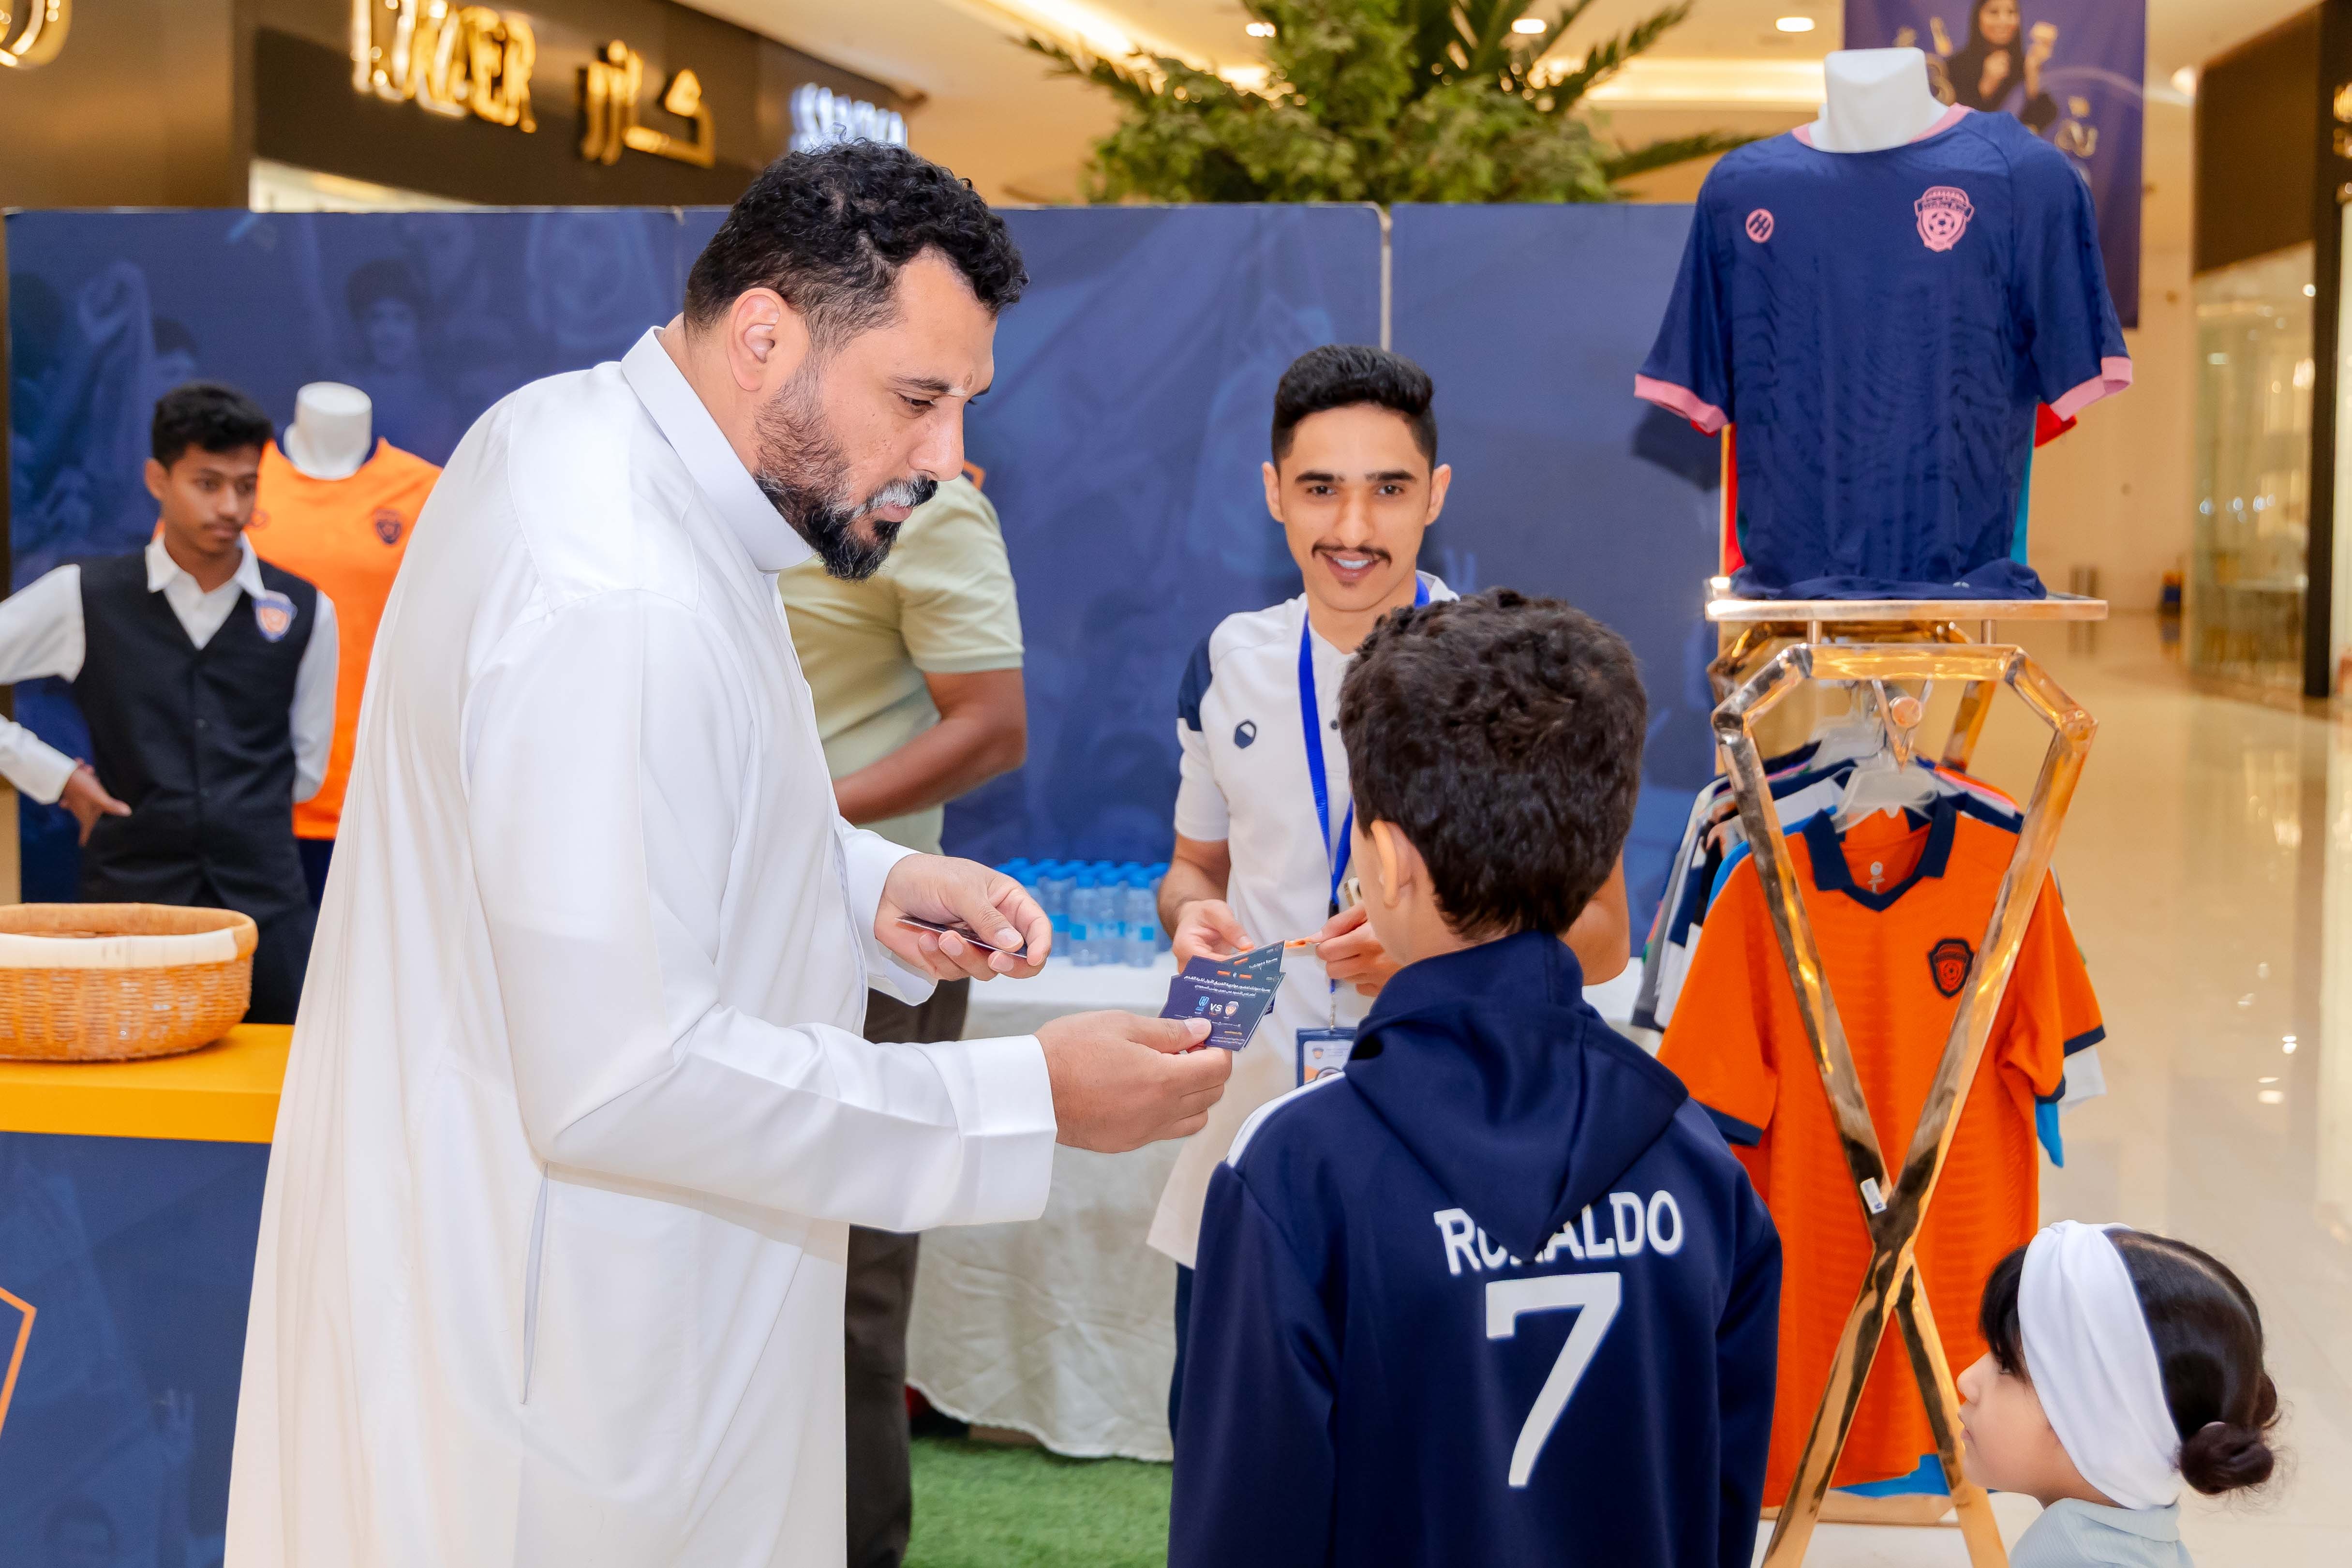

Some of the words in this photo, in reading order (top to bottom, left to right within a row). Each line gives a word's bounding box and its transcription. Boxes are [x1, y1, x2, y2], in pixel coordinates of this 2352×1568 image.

[1210, 1003, 1223, 1012] VS
[1433, 1190, 1683, 1275] ROALDO
[1485, 1271, 1621, 1488] 7
